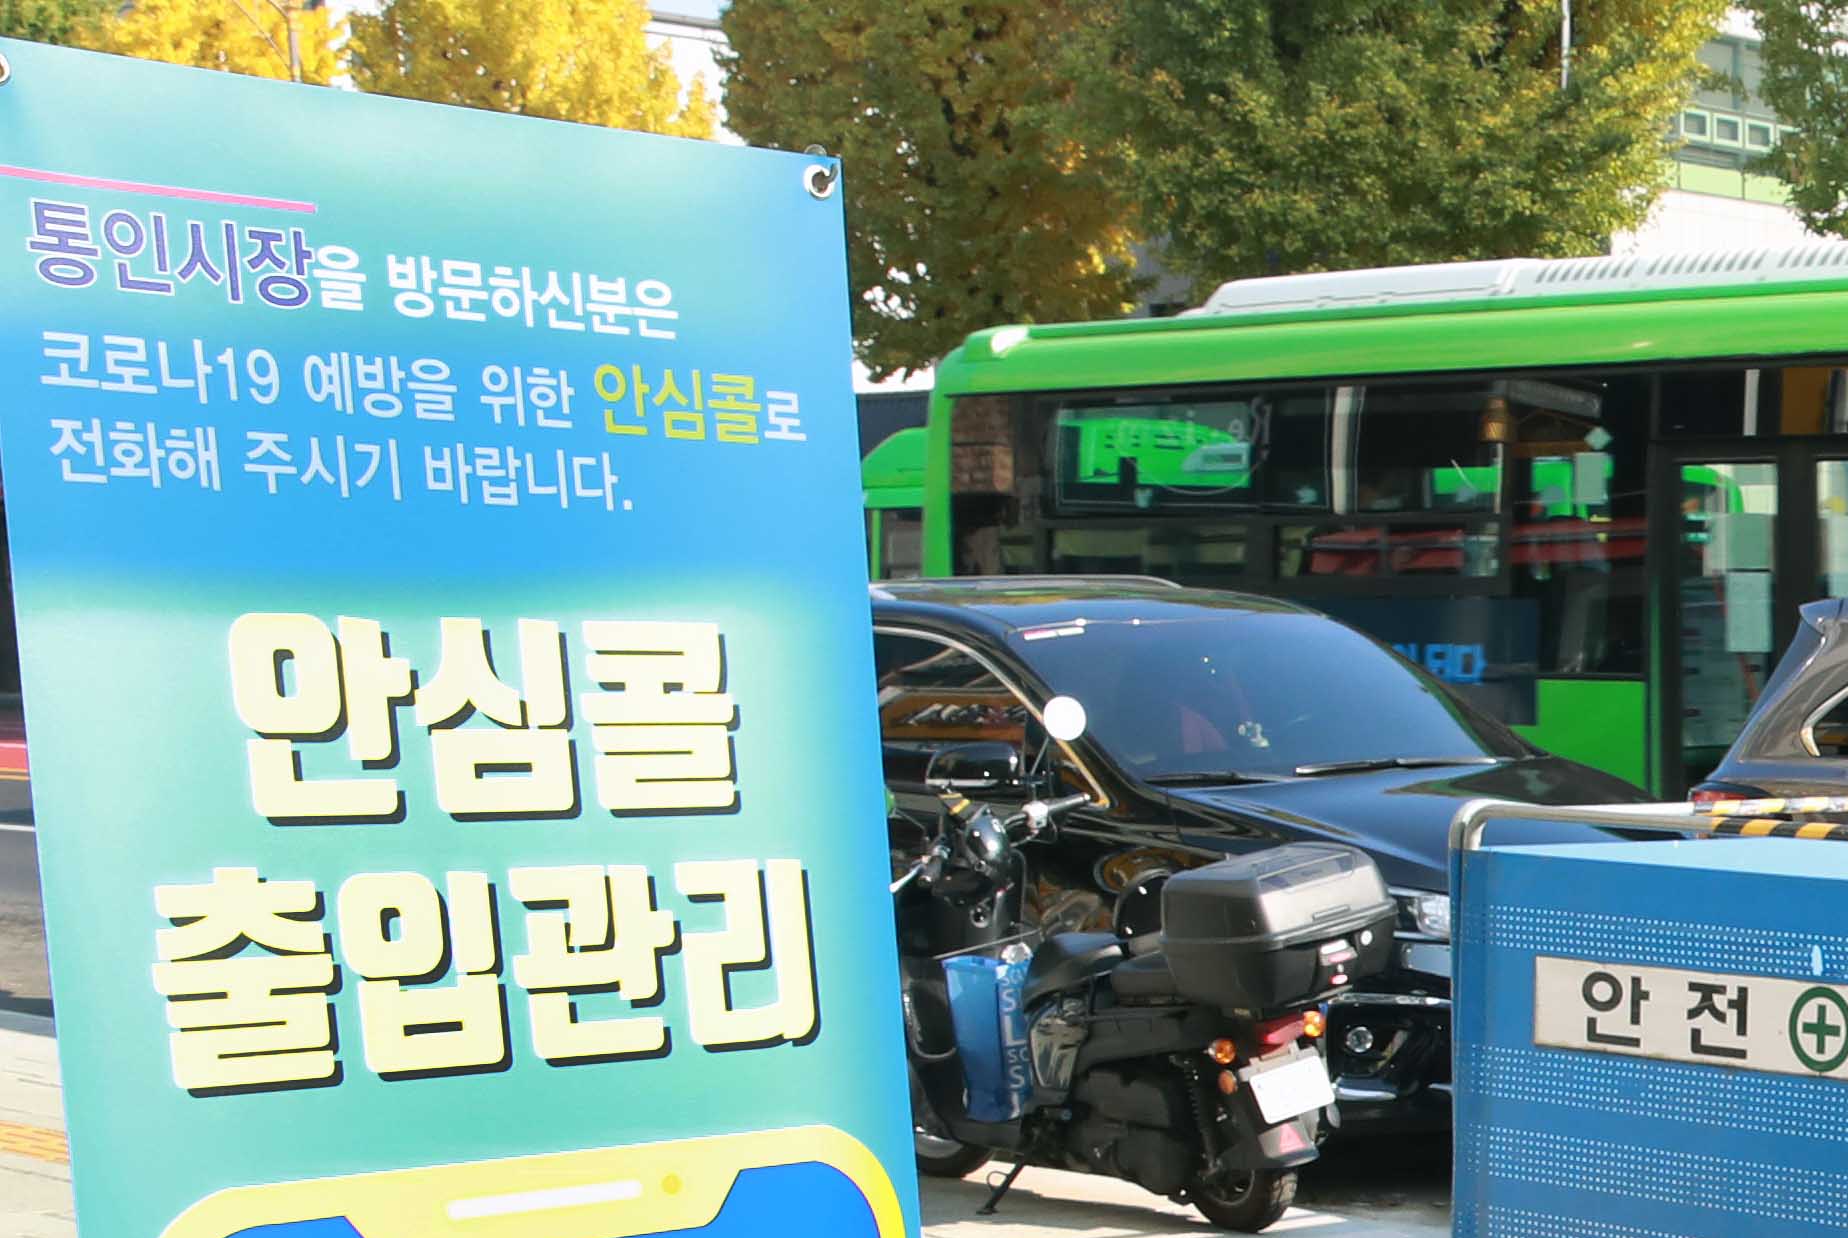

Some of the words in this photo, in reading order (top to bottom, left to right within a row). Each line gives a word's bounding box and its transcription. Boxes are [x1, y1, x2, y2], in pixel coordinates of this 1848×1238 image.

[26, 198, 366, 313] 통인시장을
[387, 253, 680, 341] 방문하신분은
[41, 332, 280, 407] 코로나19
[304, 352, 457, 422] 예방을
[480, 363, 574, 429] 위한
[594, 363, 807, 445] 안심콜로
[49, 416, 222, 493] 전화해
[243, 430, 403, 501] 주시기
[425, 444, 635, 512] 바랍니다.
[228, 612, 741, 826] 안심콜
[151, 857, 822, 1099] 출입관리
[1580, 970, 1749, 1060] 안전
